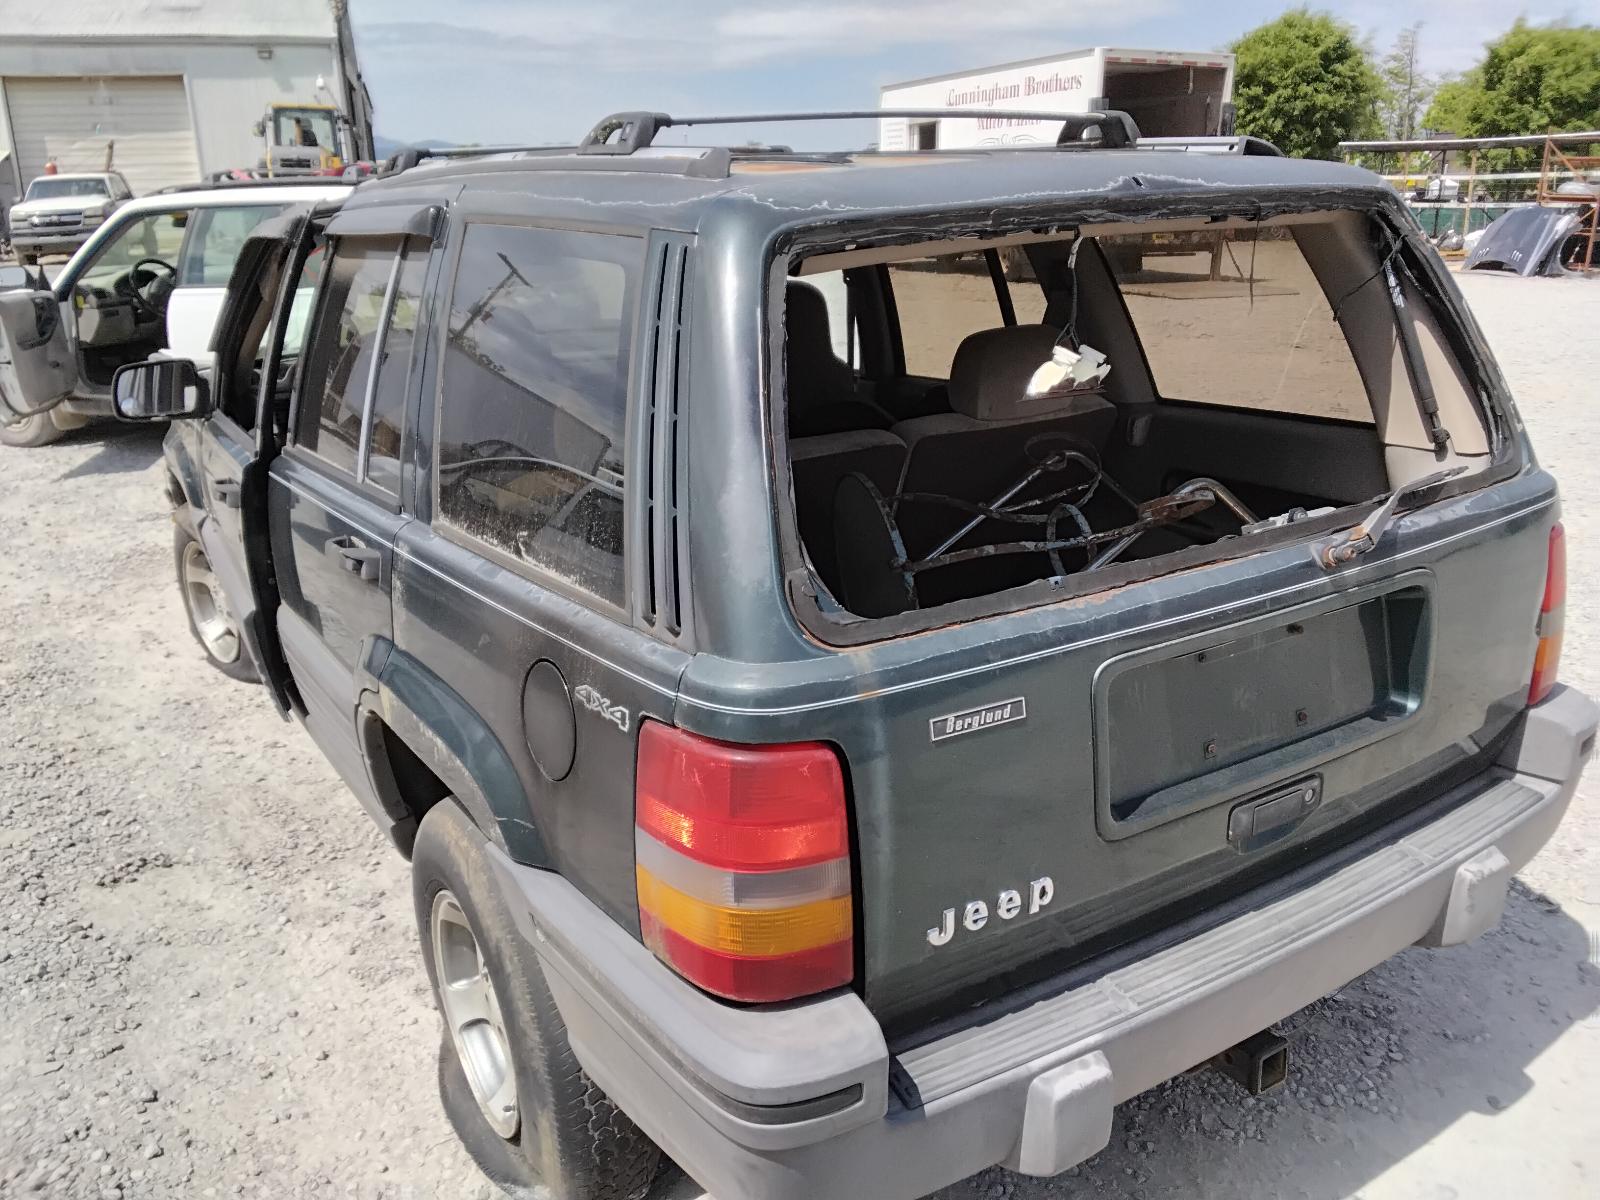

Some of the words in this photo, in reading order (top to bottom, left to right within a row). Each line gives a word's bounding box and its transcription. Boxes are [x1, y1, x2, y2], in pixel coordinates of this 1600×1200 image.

[945, 82, 1020, 107] Cunningham
[1024, 72, 1083, 97] Brothers
[945, 703, 1012, 734] Berglund
[926, 876, 1054, 946] Jeep
